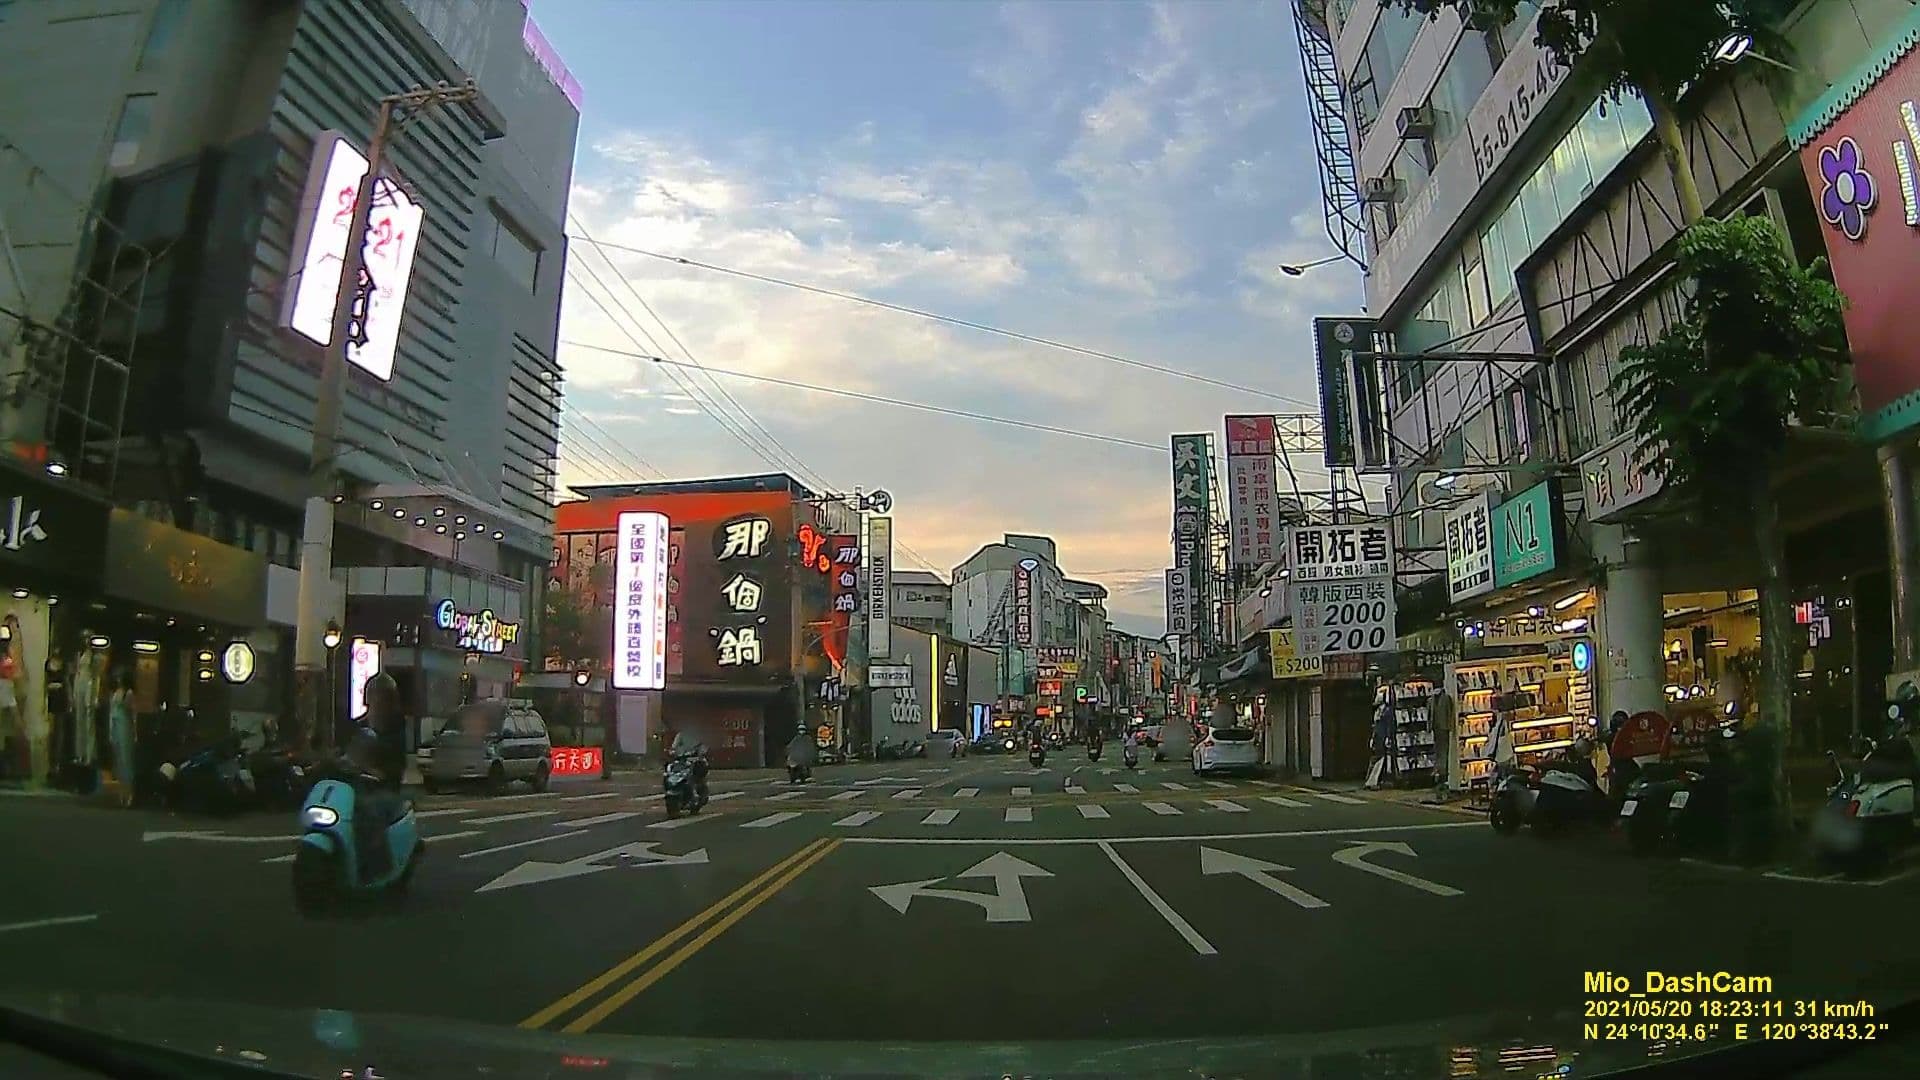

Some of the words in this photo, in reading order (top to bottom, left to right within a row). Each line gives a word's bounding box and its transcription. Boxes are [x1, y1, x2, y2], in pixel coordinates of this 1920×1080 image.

[1505, 501, 1539, 559] N1
[1295, 528, 1387, 564] 開拓者
[717, 518, 770, 666] 那個鍋
[1300, 582, 1385, 605] 韓版西裝
[1323, 601, 1386, 627] 2000
[1324, 627, 1385, 651] 200
[1286, 656, 1320, 673] $200
